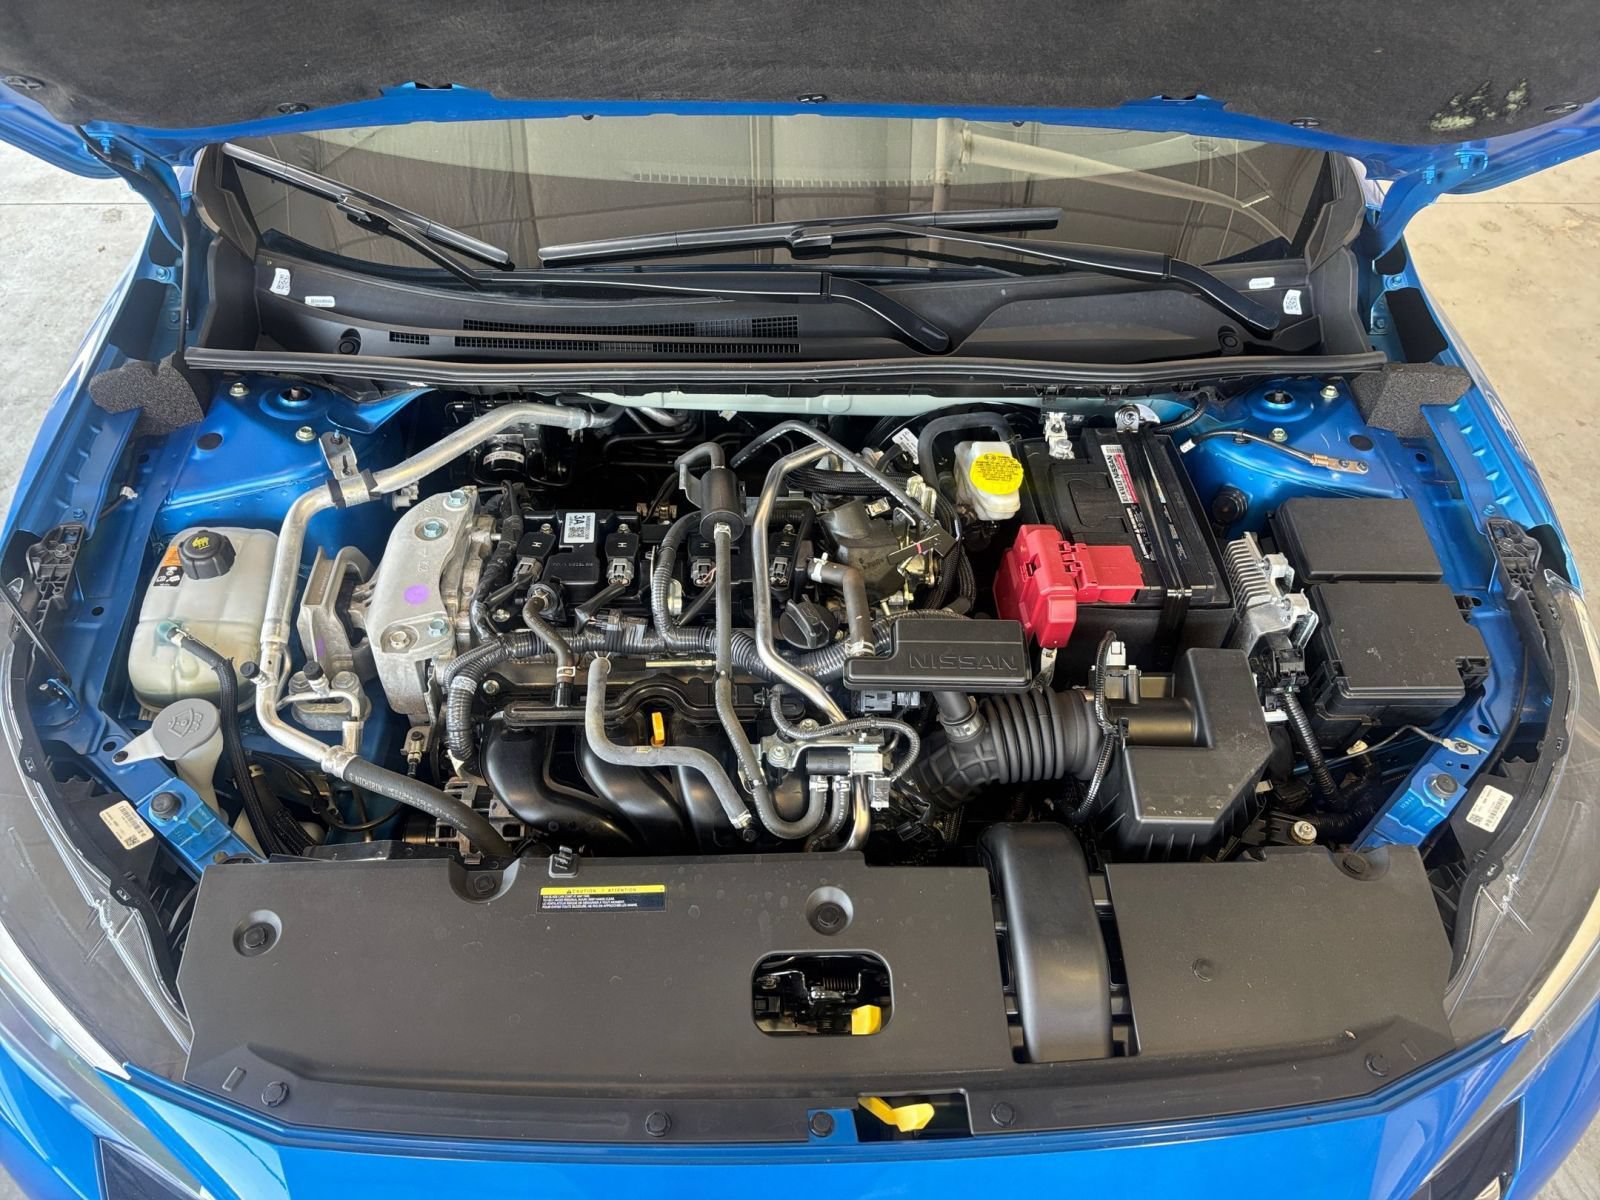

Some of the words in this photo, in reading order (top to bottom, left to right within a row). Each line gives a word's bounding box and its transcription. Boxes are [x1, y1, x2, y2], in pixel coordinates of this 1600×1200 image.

[1106, 454, 1121, 479] NISSAN
[573, 514, 586, 525] 3A
[908, 653, 1018, 671] NISSAN
